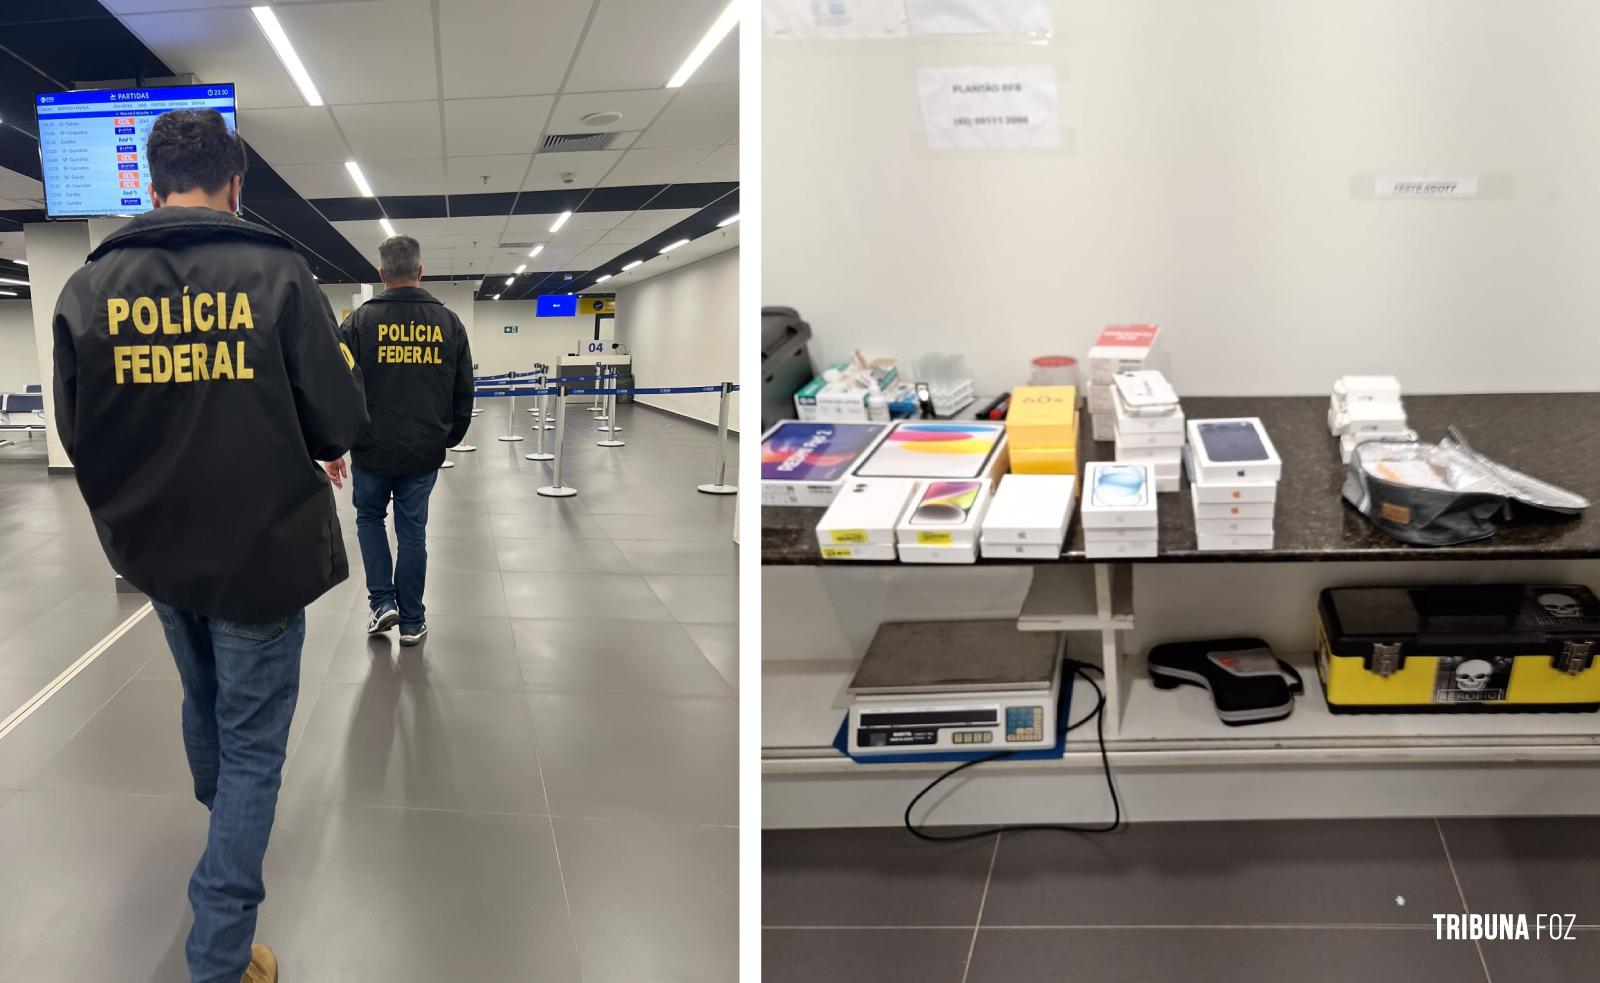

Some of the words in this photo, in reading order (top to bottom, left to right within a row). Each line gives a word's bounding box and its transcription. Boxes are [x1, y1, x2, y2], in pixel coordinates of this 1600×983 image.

[118, 92, 149, 100] PARTIDAS
[107, 286, 254, 336] POLÍCIA
[378, 321, 443, 343] POLÍCIA
[378, 345, 442, 364] FEDERAL
[588, 342, 603, 353] 04
[113, 341, 254, 384] FEDERAL
